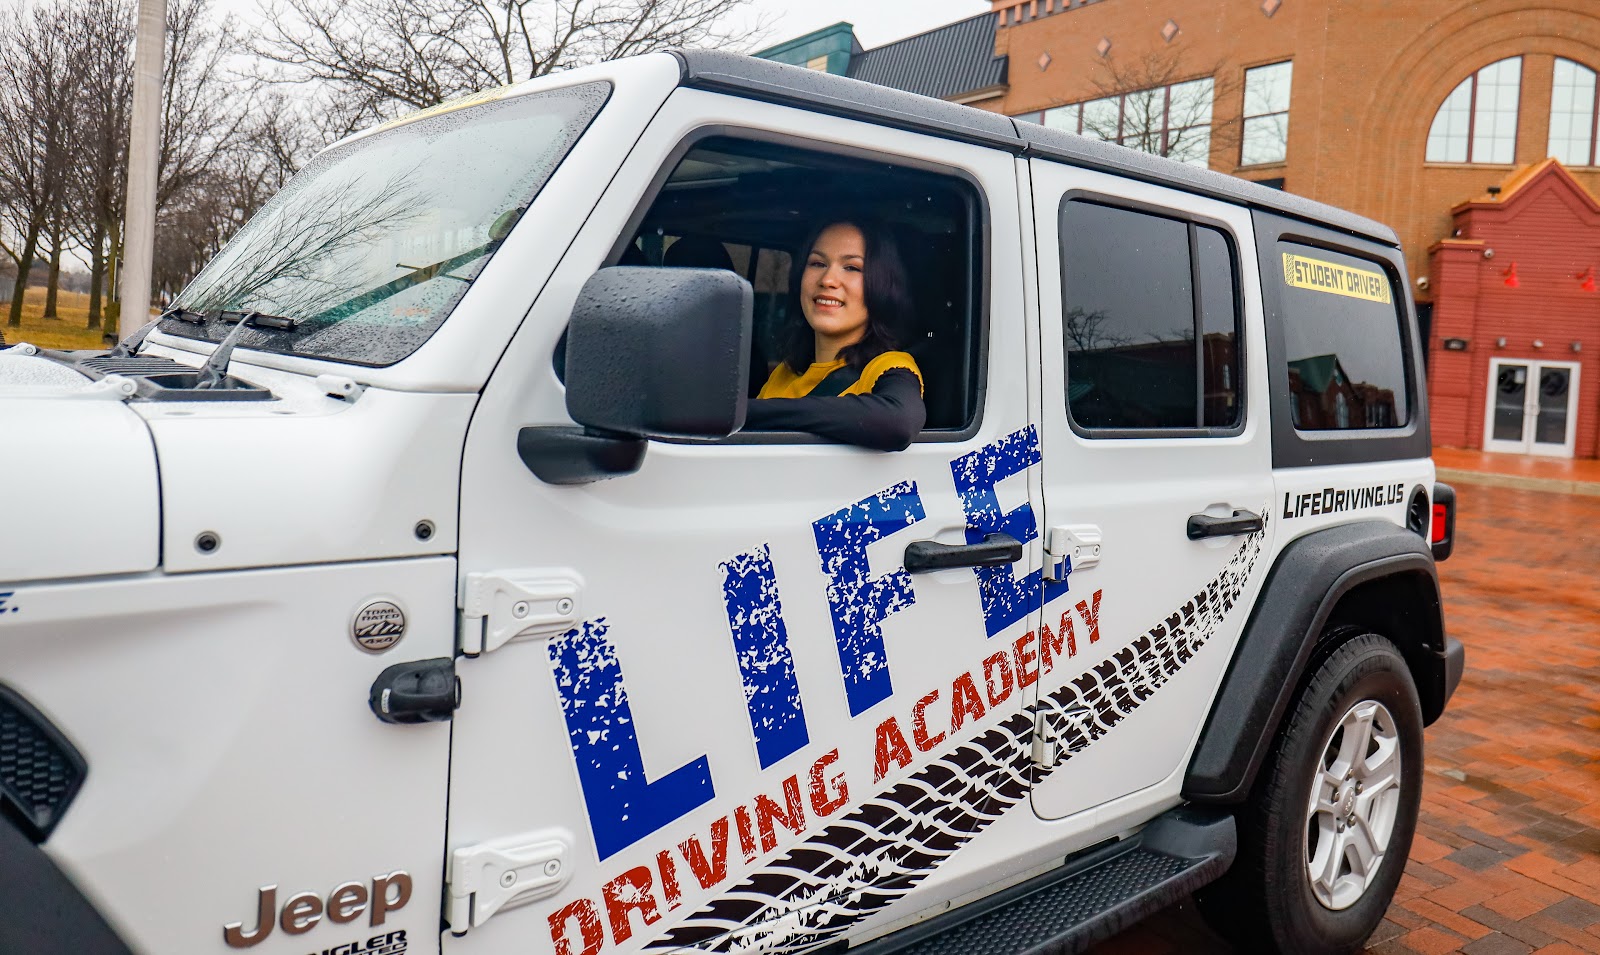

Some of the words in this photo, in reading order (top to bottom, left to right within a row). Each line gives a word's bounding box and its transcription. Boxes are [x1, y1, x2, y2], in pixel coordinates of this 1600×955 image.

[1294, 260, 1344, 291] STUDENT
[1345, 271, 1382, 298] DRIVER
[546, 424, 1072, 863] LIFE
[546, 748, 851, 955] DRIVING
[873, 588, 1103, 785] ACADEMY
[223, 869, 413, 950] Jeep
